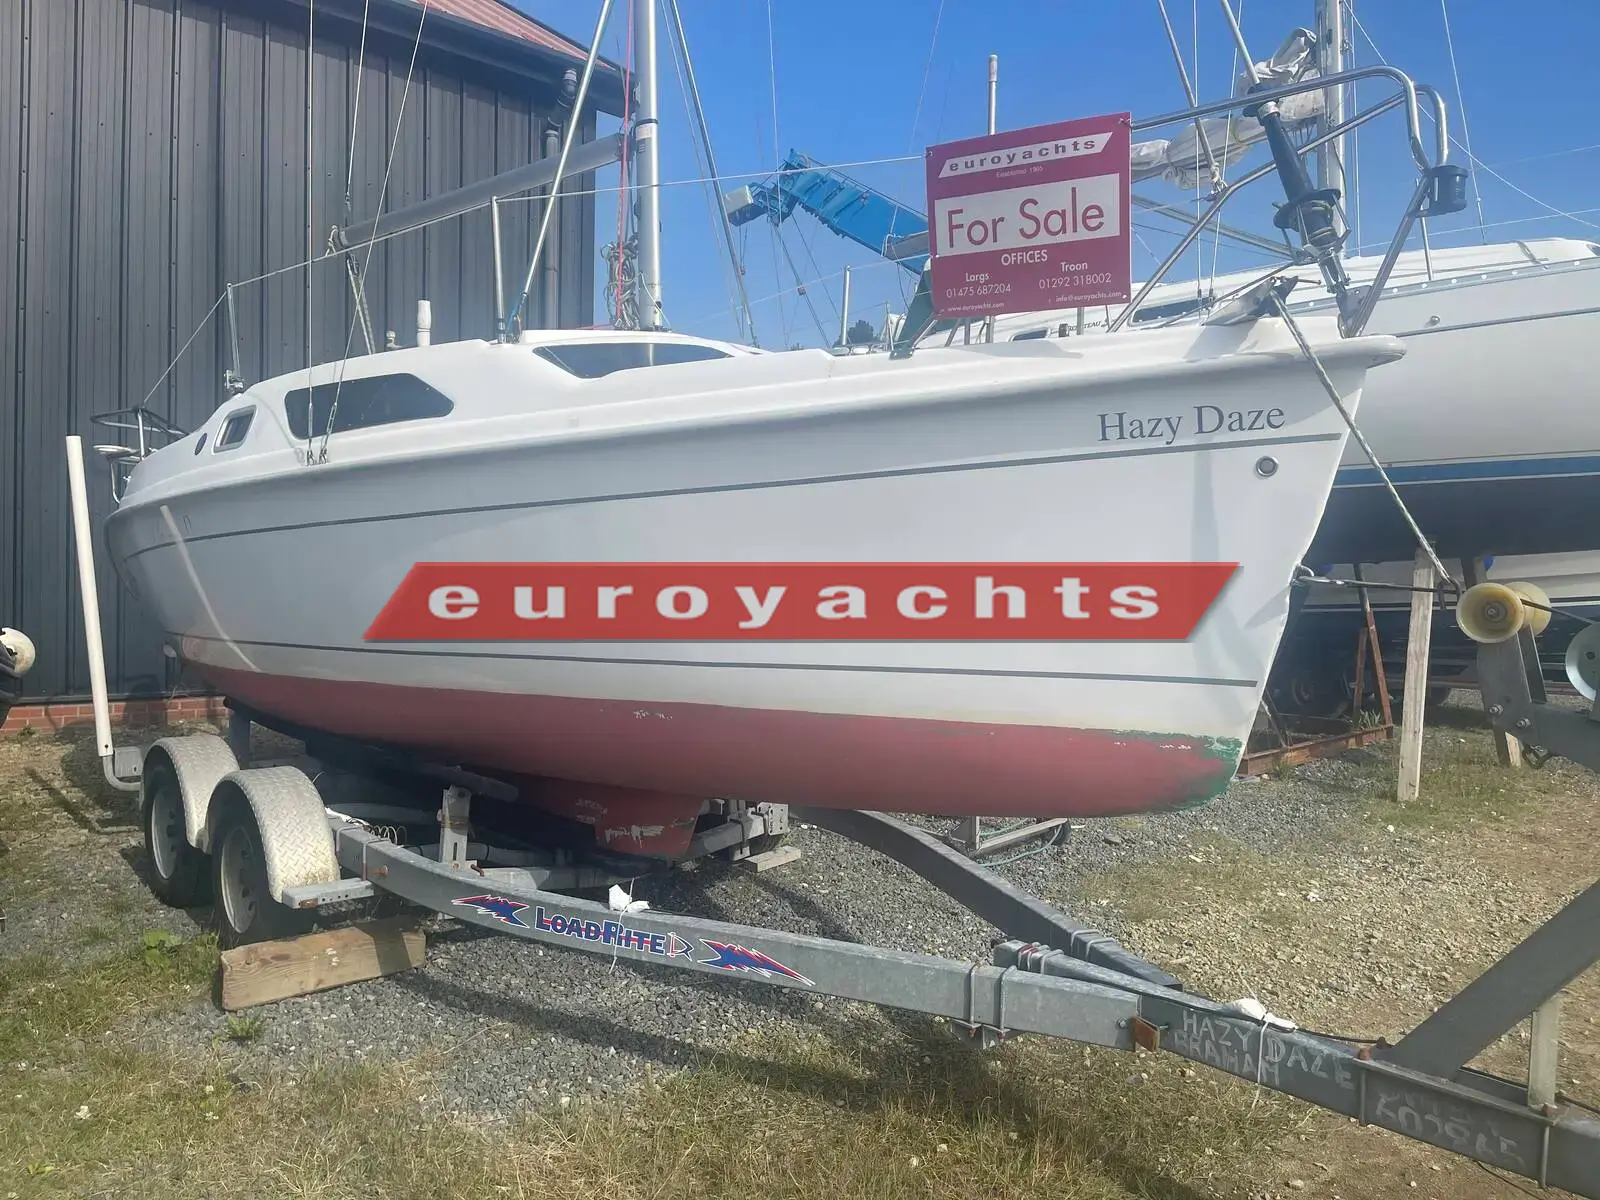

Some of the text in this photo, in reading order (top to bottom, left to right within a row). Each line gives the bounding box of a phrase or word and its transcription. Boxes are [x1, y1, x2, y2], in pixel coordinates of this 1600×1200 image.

[950, 139, 1096, 172] euroyachts
[948, 186, 1104, 248] For Sale
[1001, 250, 1048, 266] OFFICES
[1060, 262, 1088, 272] Troon
[946, 283, 1011, 298] 01475 687204
[1039, 272, 1112, 289] 01292 318002
[1097, 405, 1286, 445] Hazy Daze
[1183, 1009, 1354, 1090] HAZY DAZE
